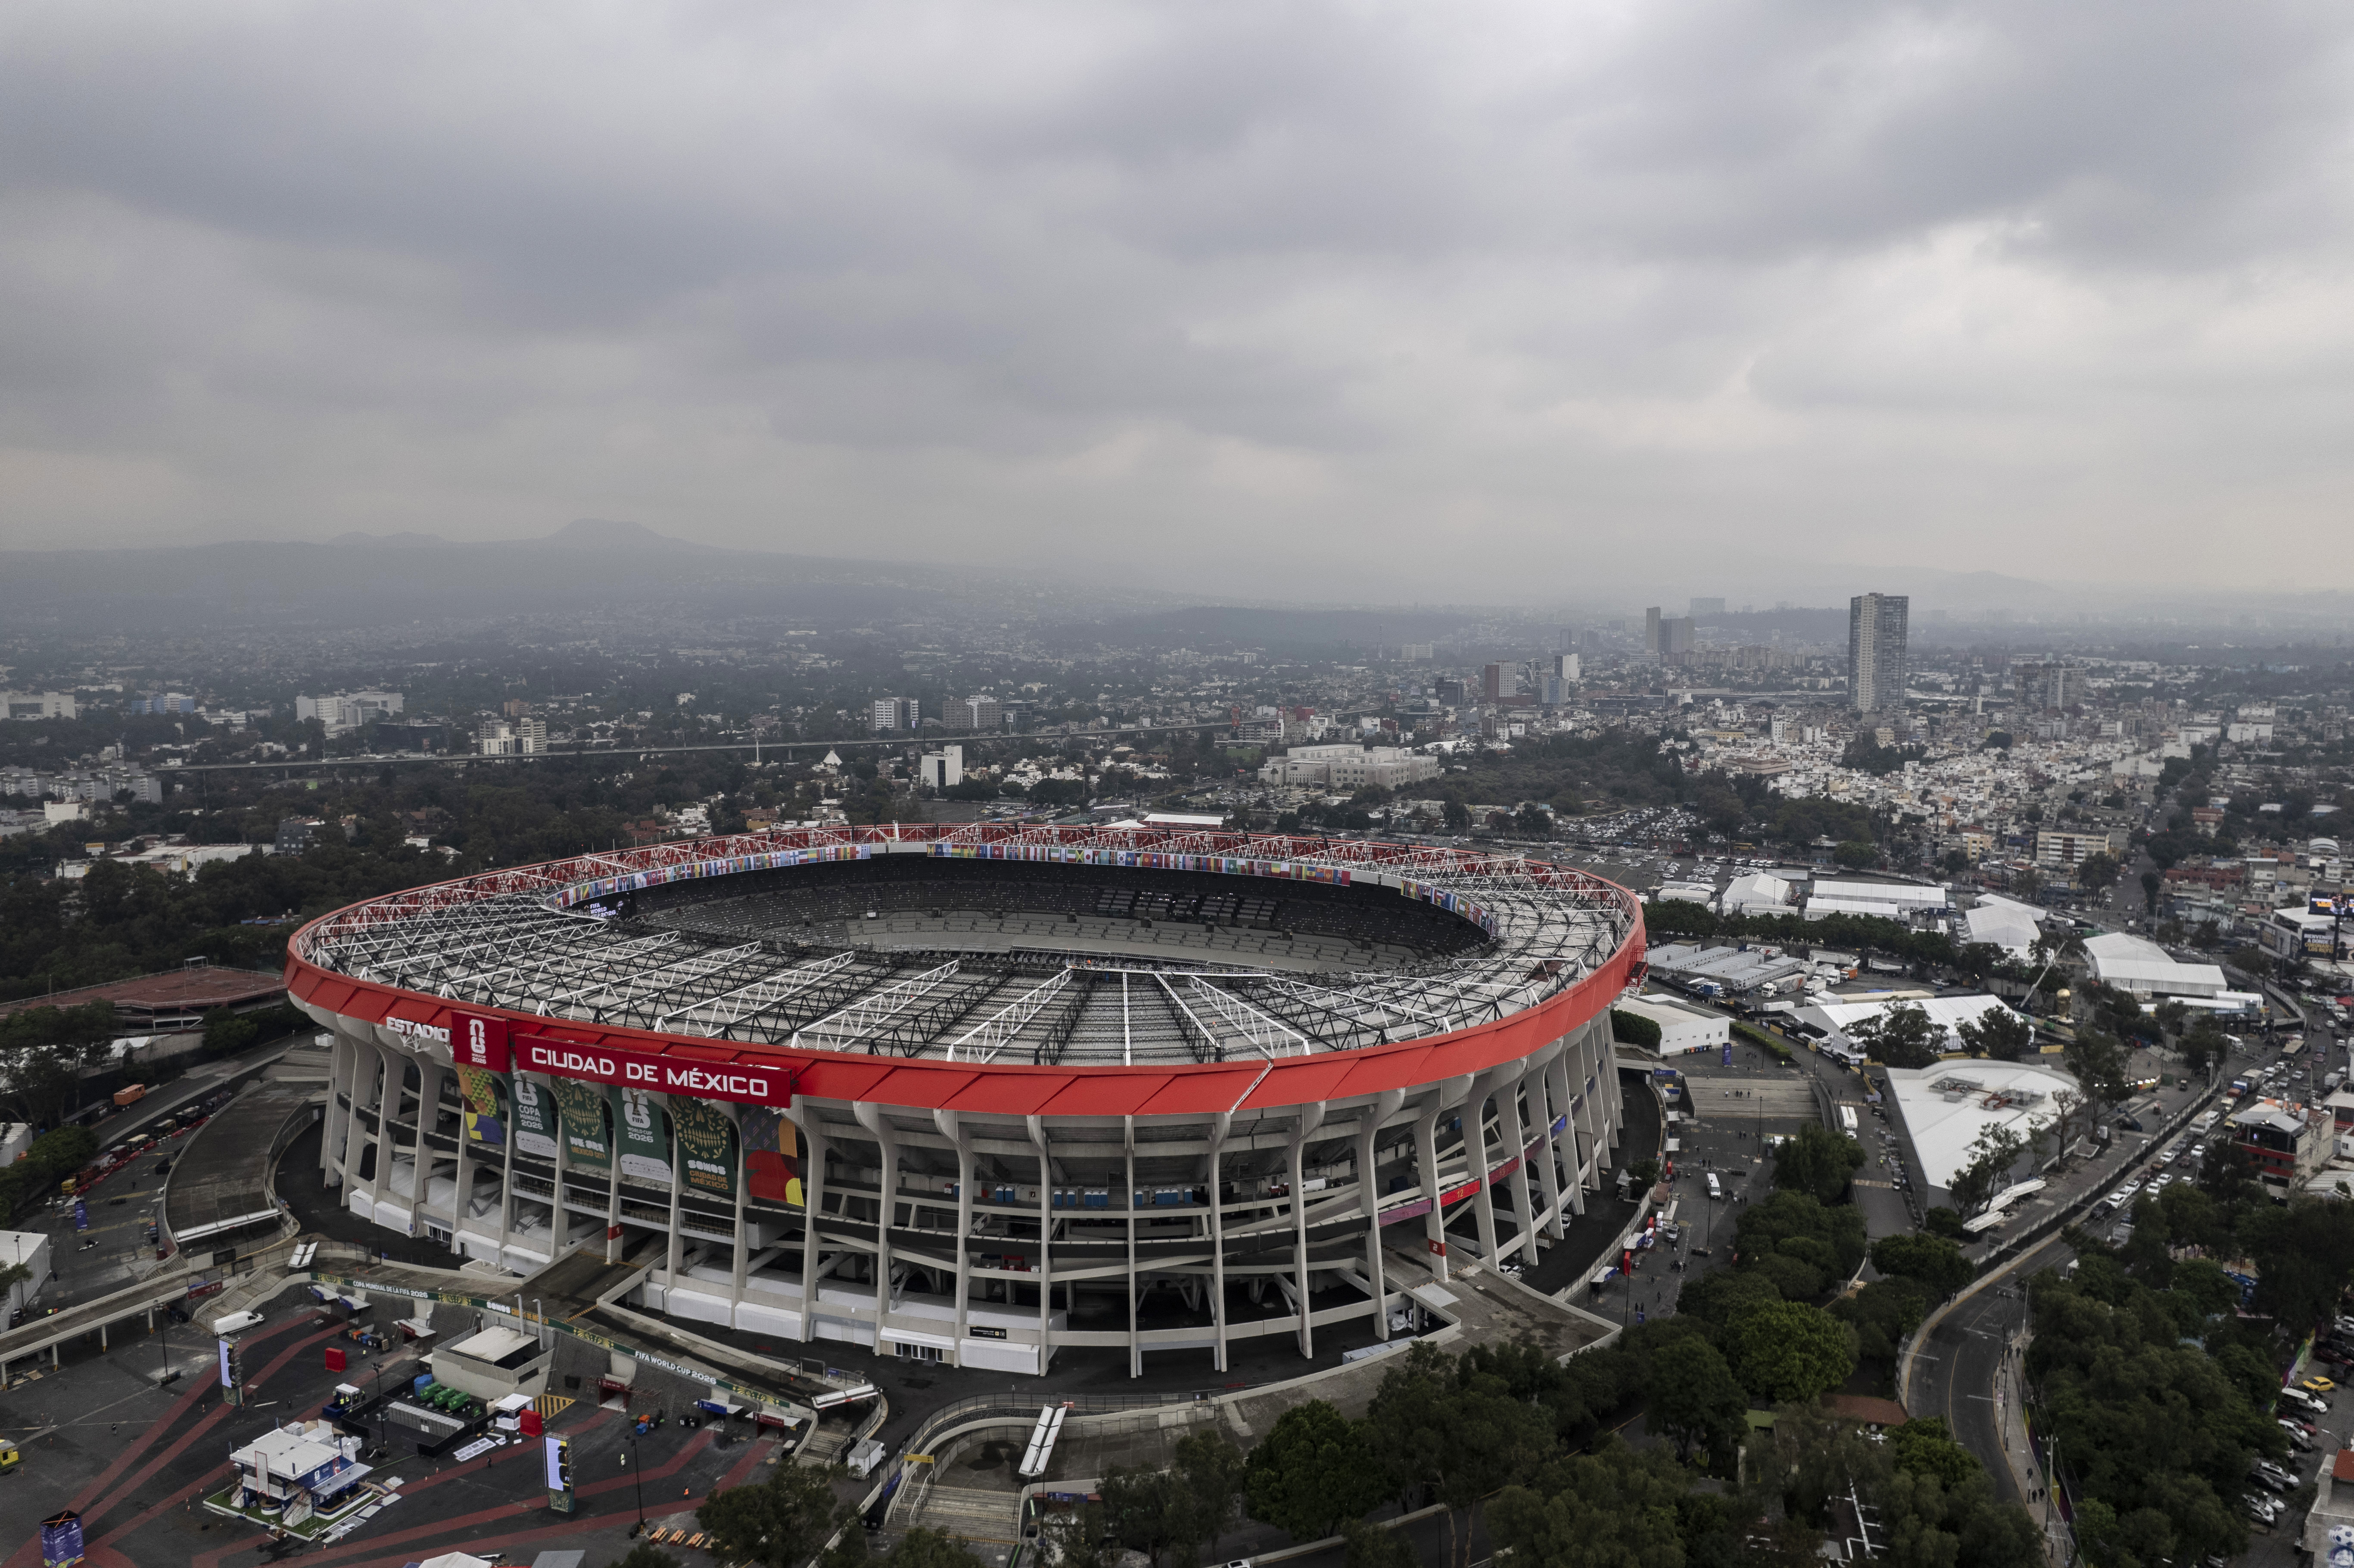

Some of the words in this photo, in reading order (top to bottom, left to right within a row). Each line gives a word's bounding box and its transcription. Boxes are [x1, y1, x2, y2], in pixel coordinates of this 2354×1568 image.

[386, 1017, 450, 1042] ESTADIO
[532, 1047, 615, 1076] CIUDAD
[626, 1063, 658, 1082] DE
[667, 1067, 768, 1097] MÉXICO
[518, 1105, 541, 1117] COPA
[520, 1114, 542, 1123] MUNDIAL
[521, 1120, 543, 1130] 2026
[628, 1132, 654, 1143] 2026
[570, 1136, 585, 1147] WE
[585, 1140, 604, 1153] ARE
[571, 1146, 594, 1157] MEXICO
[595, 1151, 606, 1160] CITY
[688, 1160, 726, 1175] SOMOS
[689, 1170, 716, 1181] CIUDAD
[690, 1177, 729, 1190] MÉXICO
[1457, 1189, 1464, 1198] 12
[1432, 1243, 1438, 1251] 2
[366, 1282, 386, 1291] MUNDIAL
[411, 1290, 428, 1298] 2026
[486, 1301, 511, 1313] SOMOS
[635, 1350, 649, 1361] FIFA
[651, 1356, 676, 1370] WORLD
[676, 1366, 691, 1375] CUP
[691, 1371, 716, 1384] 2026
